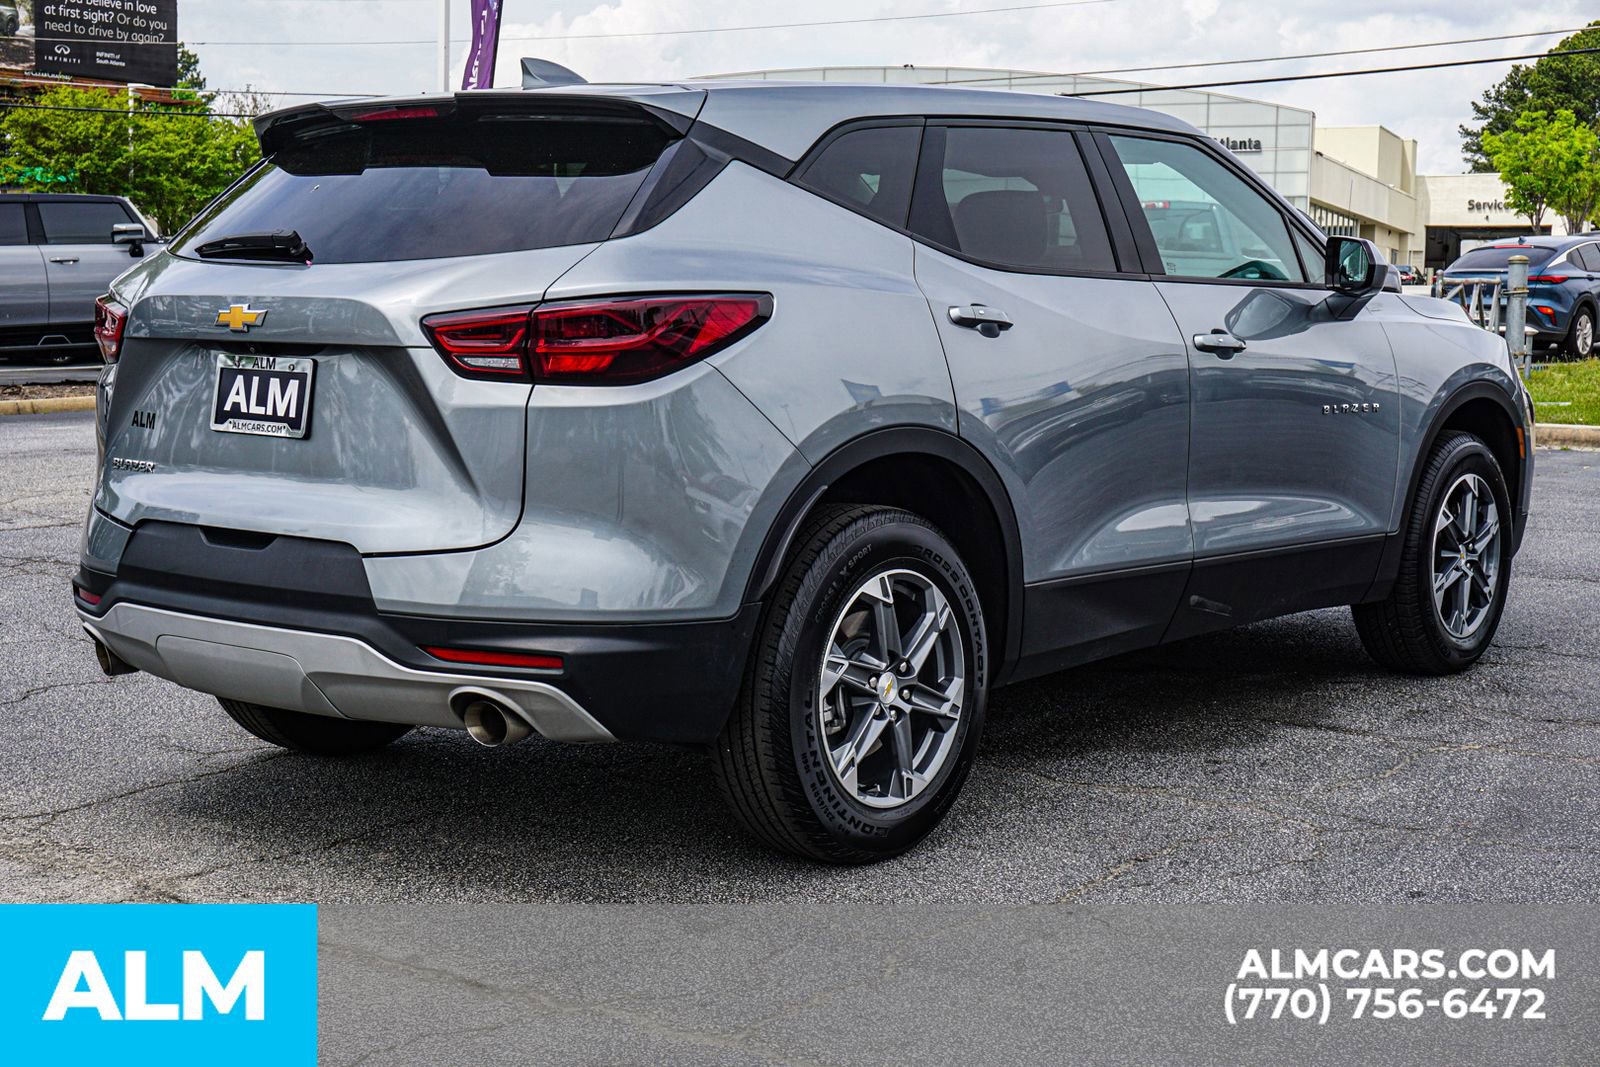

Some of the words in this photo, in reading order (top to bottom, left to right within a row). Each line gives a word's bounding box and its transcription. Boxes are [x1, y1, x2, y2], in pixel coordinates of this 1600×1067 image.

[124, 0, 134, 11] in
[136, 0, 157, 15] love
[44, 5, 56, 16] at
[59, 4, 81, 19] first
[83, 8, 115, 24] sight?
[116, 12, 131, 25] Or
[132, 15, 147, 28] do
[149, 20, 168, 31] you
[44, 21, 71, 33] need
[74, 23, 86, 34] to
[88, 25, 114, 38] drive
[116, 27, 129, 43] by
[131, 32, 165, 44] again?
[44, 55, 81, 64] INFINITI
[1214, 136, 1262, 150] tlanta
[1467, 199, 1510, 211] Servic
[252, 357, 277, 370] ALM
[223, 374, 300, 418] ALM
[1321, 402, 1380, 416] BLAZER
[131, 410, 156, 430] ALM
[112, 457, 156, 474] BLAZER
[848, 543, 872, 569] SPORT
